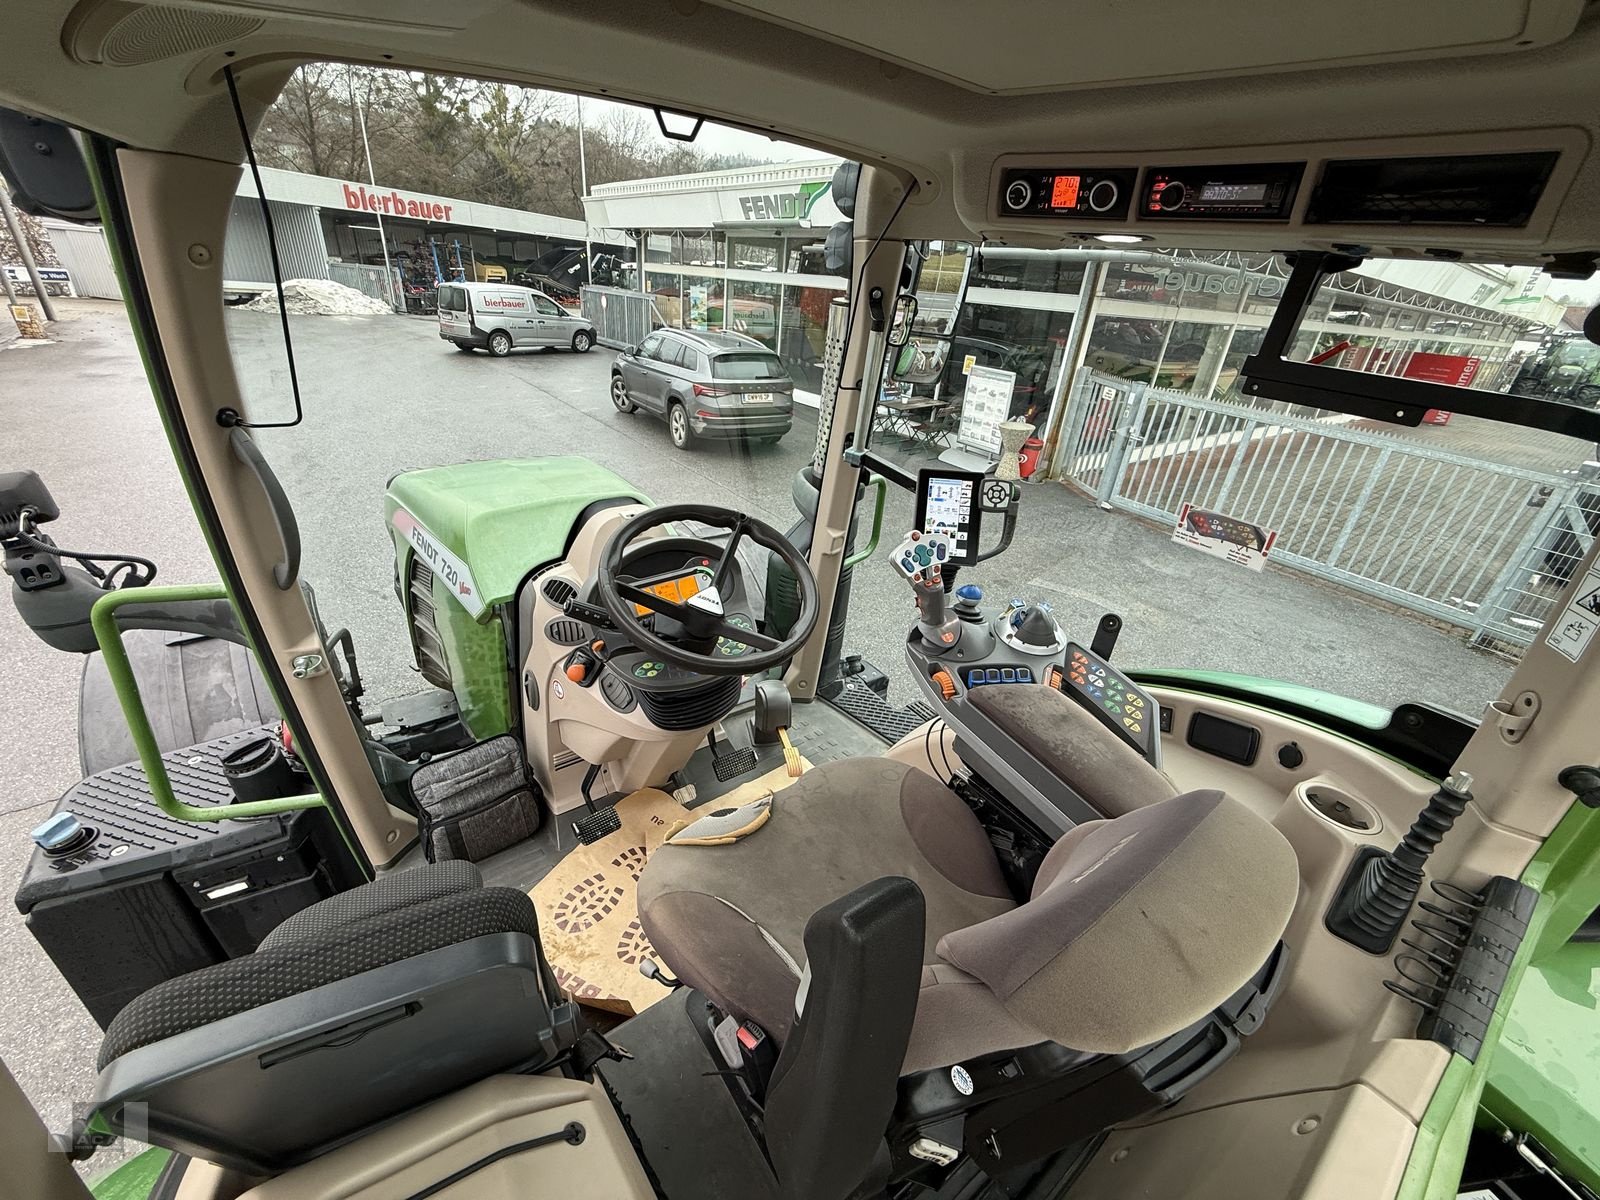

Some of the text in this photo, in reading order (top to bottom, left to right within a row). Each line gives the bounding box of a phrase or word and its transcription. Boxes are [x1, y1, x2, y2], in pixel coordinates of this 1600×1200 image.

[343, 184, 452, 221] bierbauer
[739, 193, 811, 220] FENDT
[484, 296, 526, 309] bierbauer
[412, 526, 439, 565] FENDT
[441, 557, 458, 587] 720
